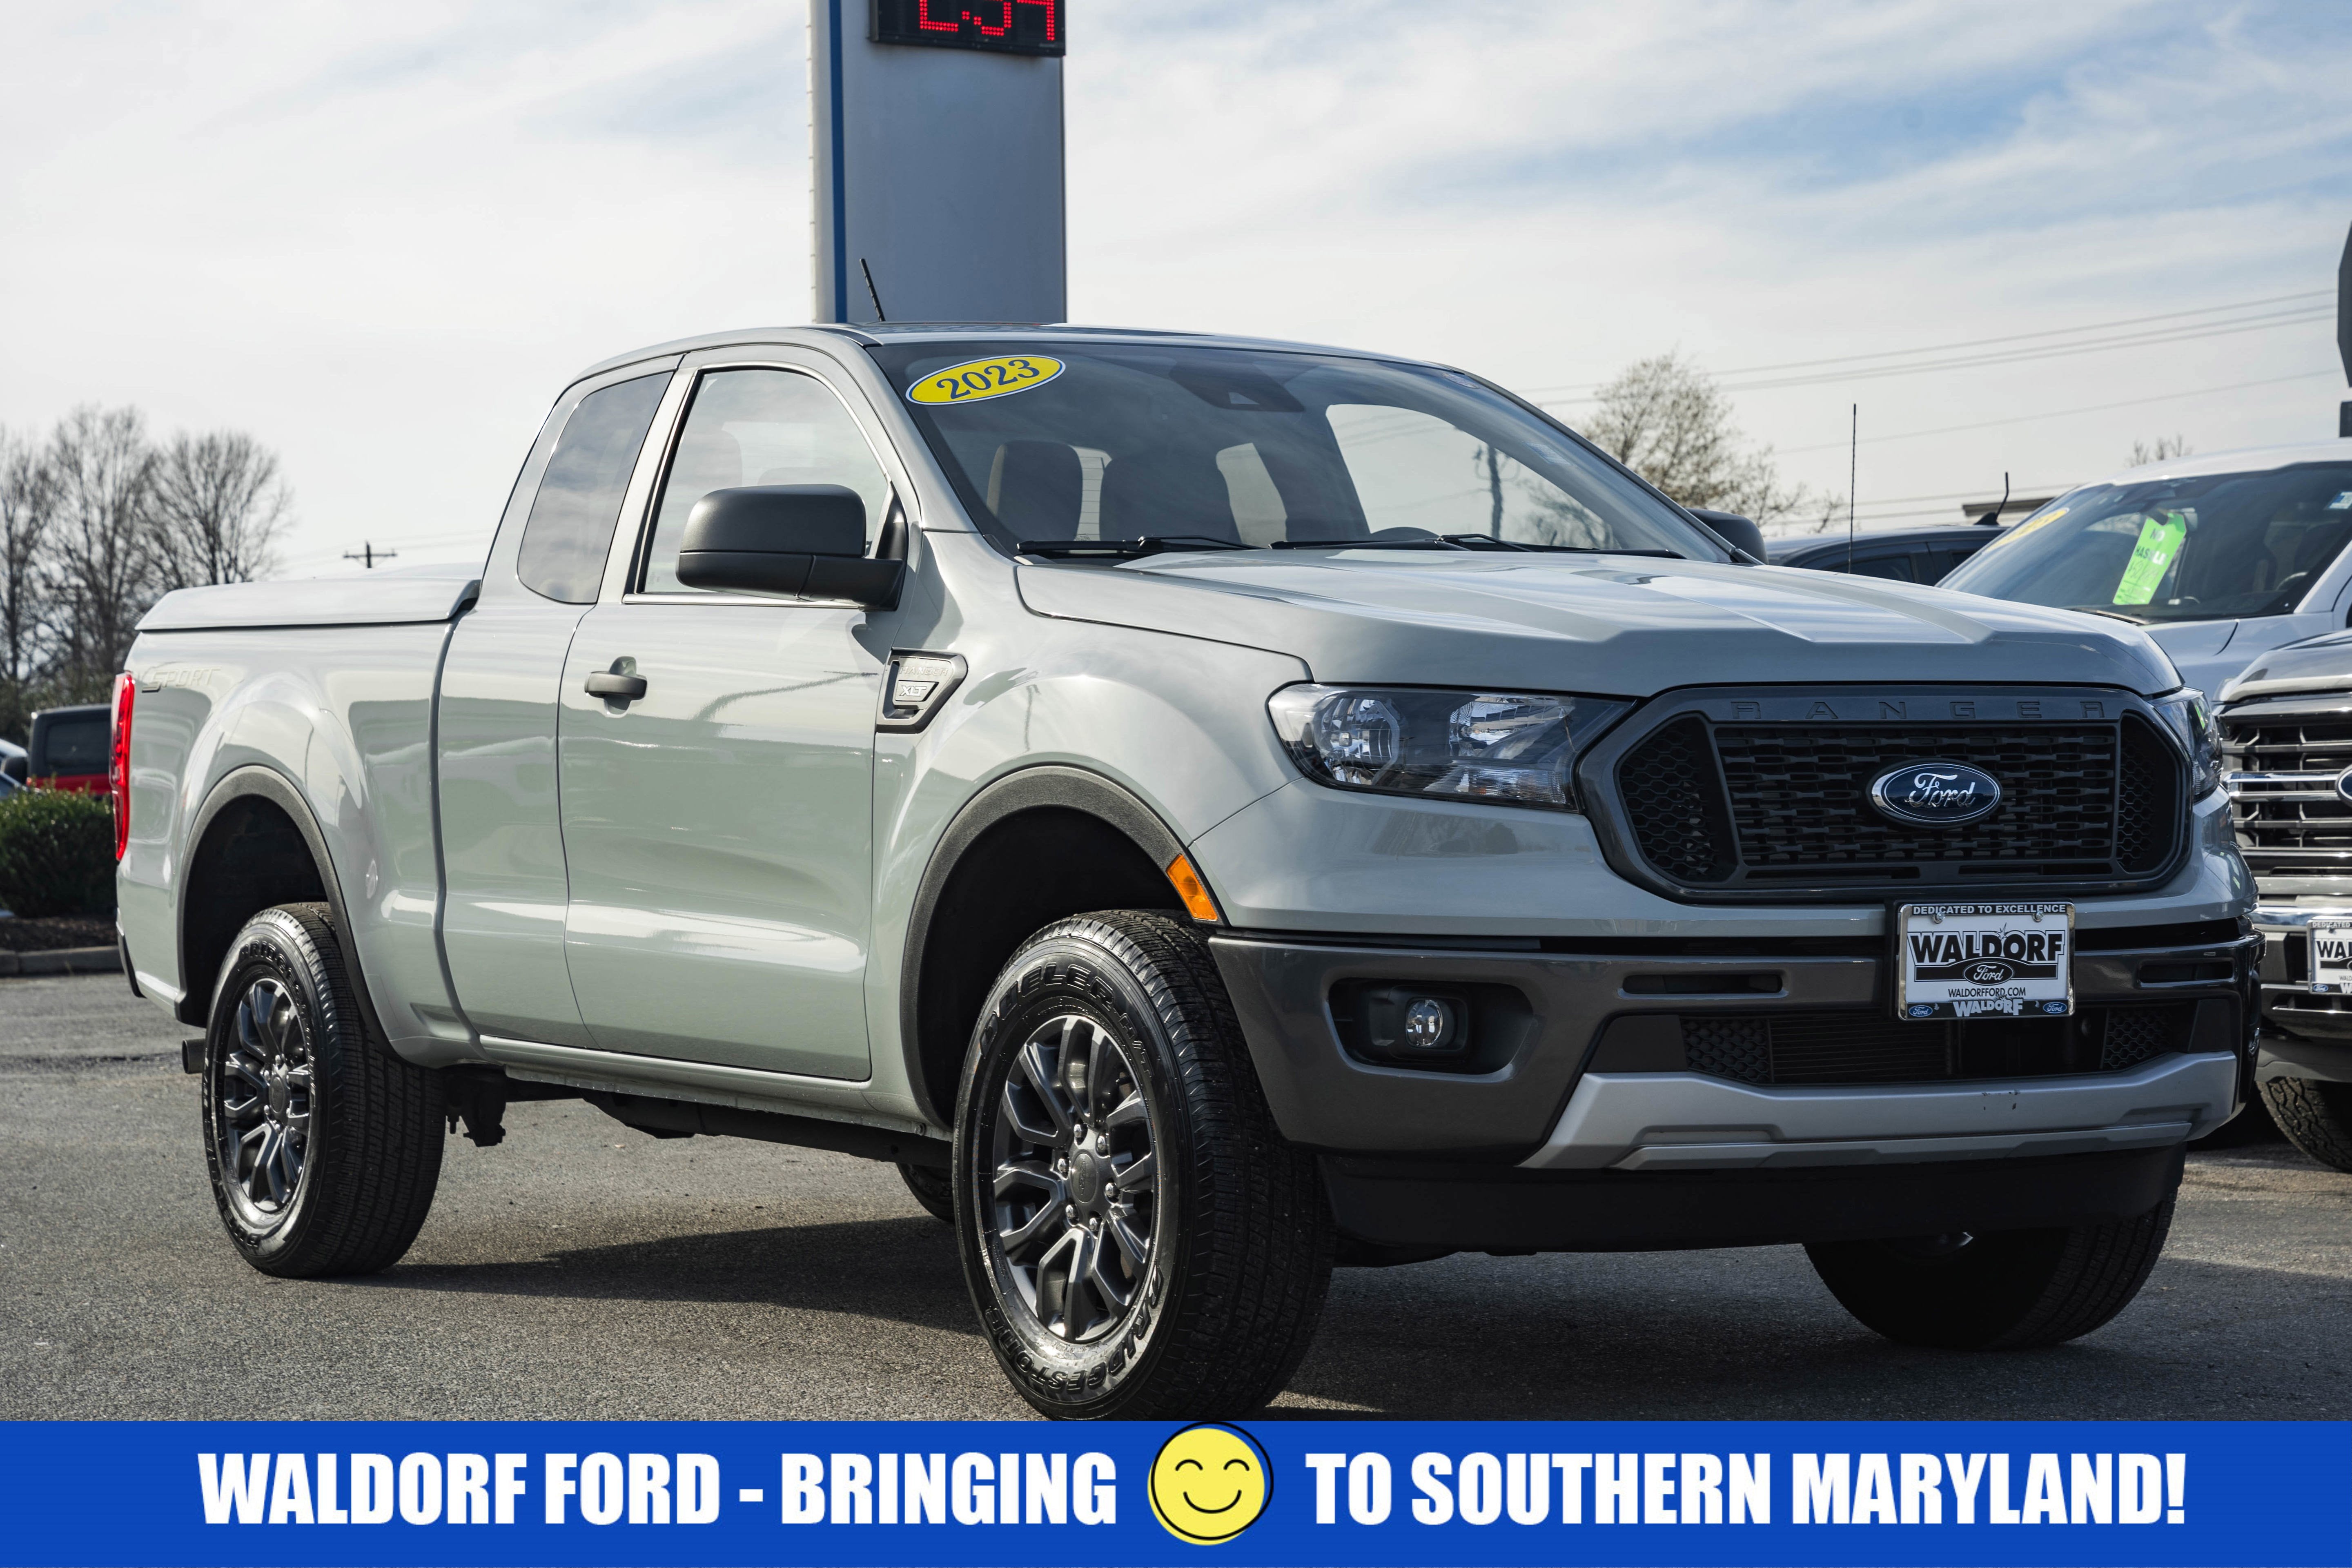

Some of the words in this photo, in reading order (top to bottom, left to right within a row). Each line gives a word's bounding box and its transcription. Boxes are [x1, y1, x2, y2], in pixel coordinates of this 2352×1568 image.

[936, 359, 1040, 400] 2023
[142, 667, 222, 693] SPORT
[899, 666, 949, 676] RANGER
[900, 685, 927, 697] XLT
[1731, 701, 2105, 719] RANGER
[1909, 772, 1976, 808] Ford
[1913, 906, 1977, 914] DEDICATED
[1980, 905, 1993, 913] TO
[1996, 904, 2066, 913] EXCELLENCE
[1909, 933, 2063, 964] WALDORF
[1973, 964, 2004, 981] Ford
[1948, 987, 2026, 998] WALDORFFORD.COM
[980, 962, 1115, 1059] DUELER
[1912, 1007, 1929, 1016] Ford
[1953, 998, 2024, 1017] WALDORF
[2046, 1003, 2063, 1013] Ford
[985, 1265, 1164, 1394] BRIDGESTONE
